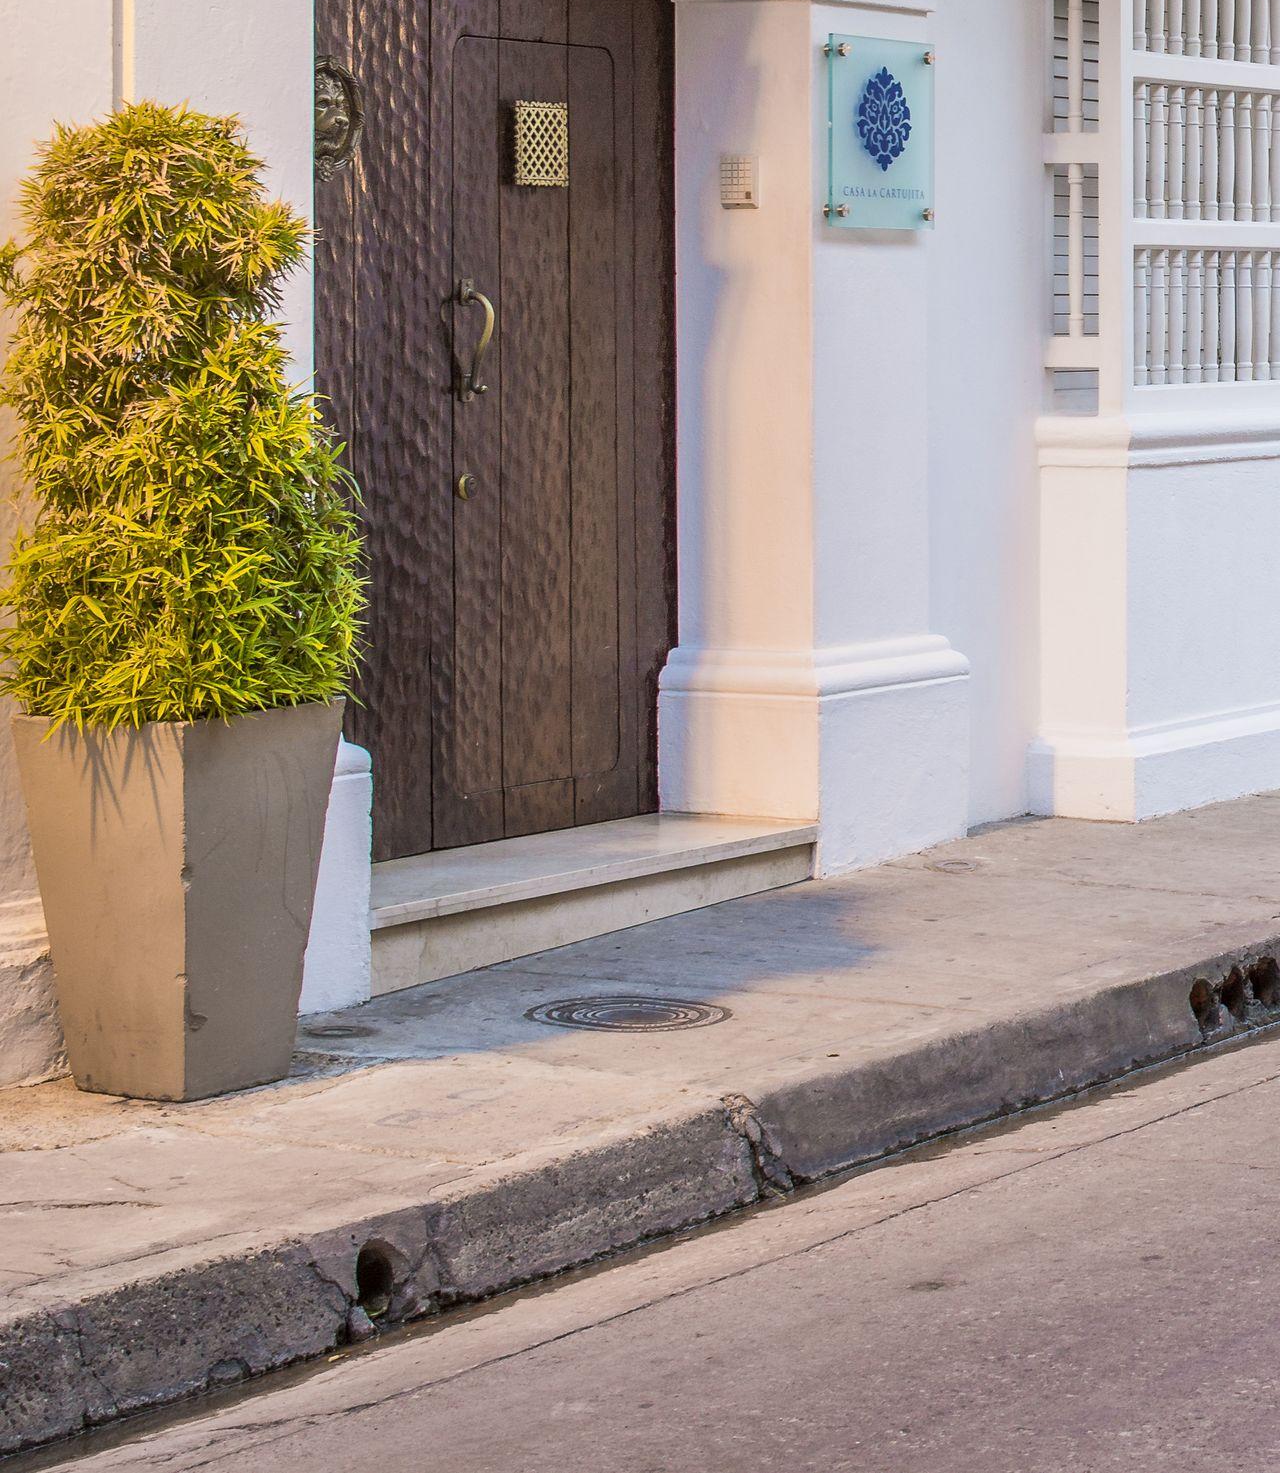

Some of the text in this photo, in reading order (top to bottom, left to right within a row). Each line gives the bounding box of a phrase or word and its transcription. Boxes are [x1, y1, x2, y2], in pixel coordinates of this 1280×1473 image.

[843, 186, 925, 200] CASA LA CARTUJITA
